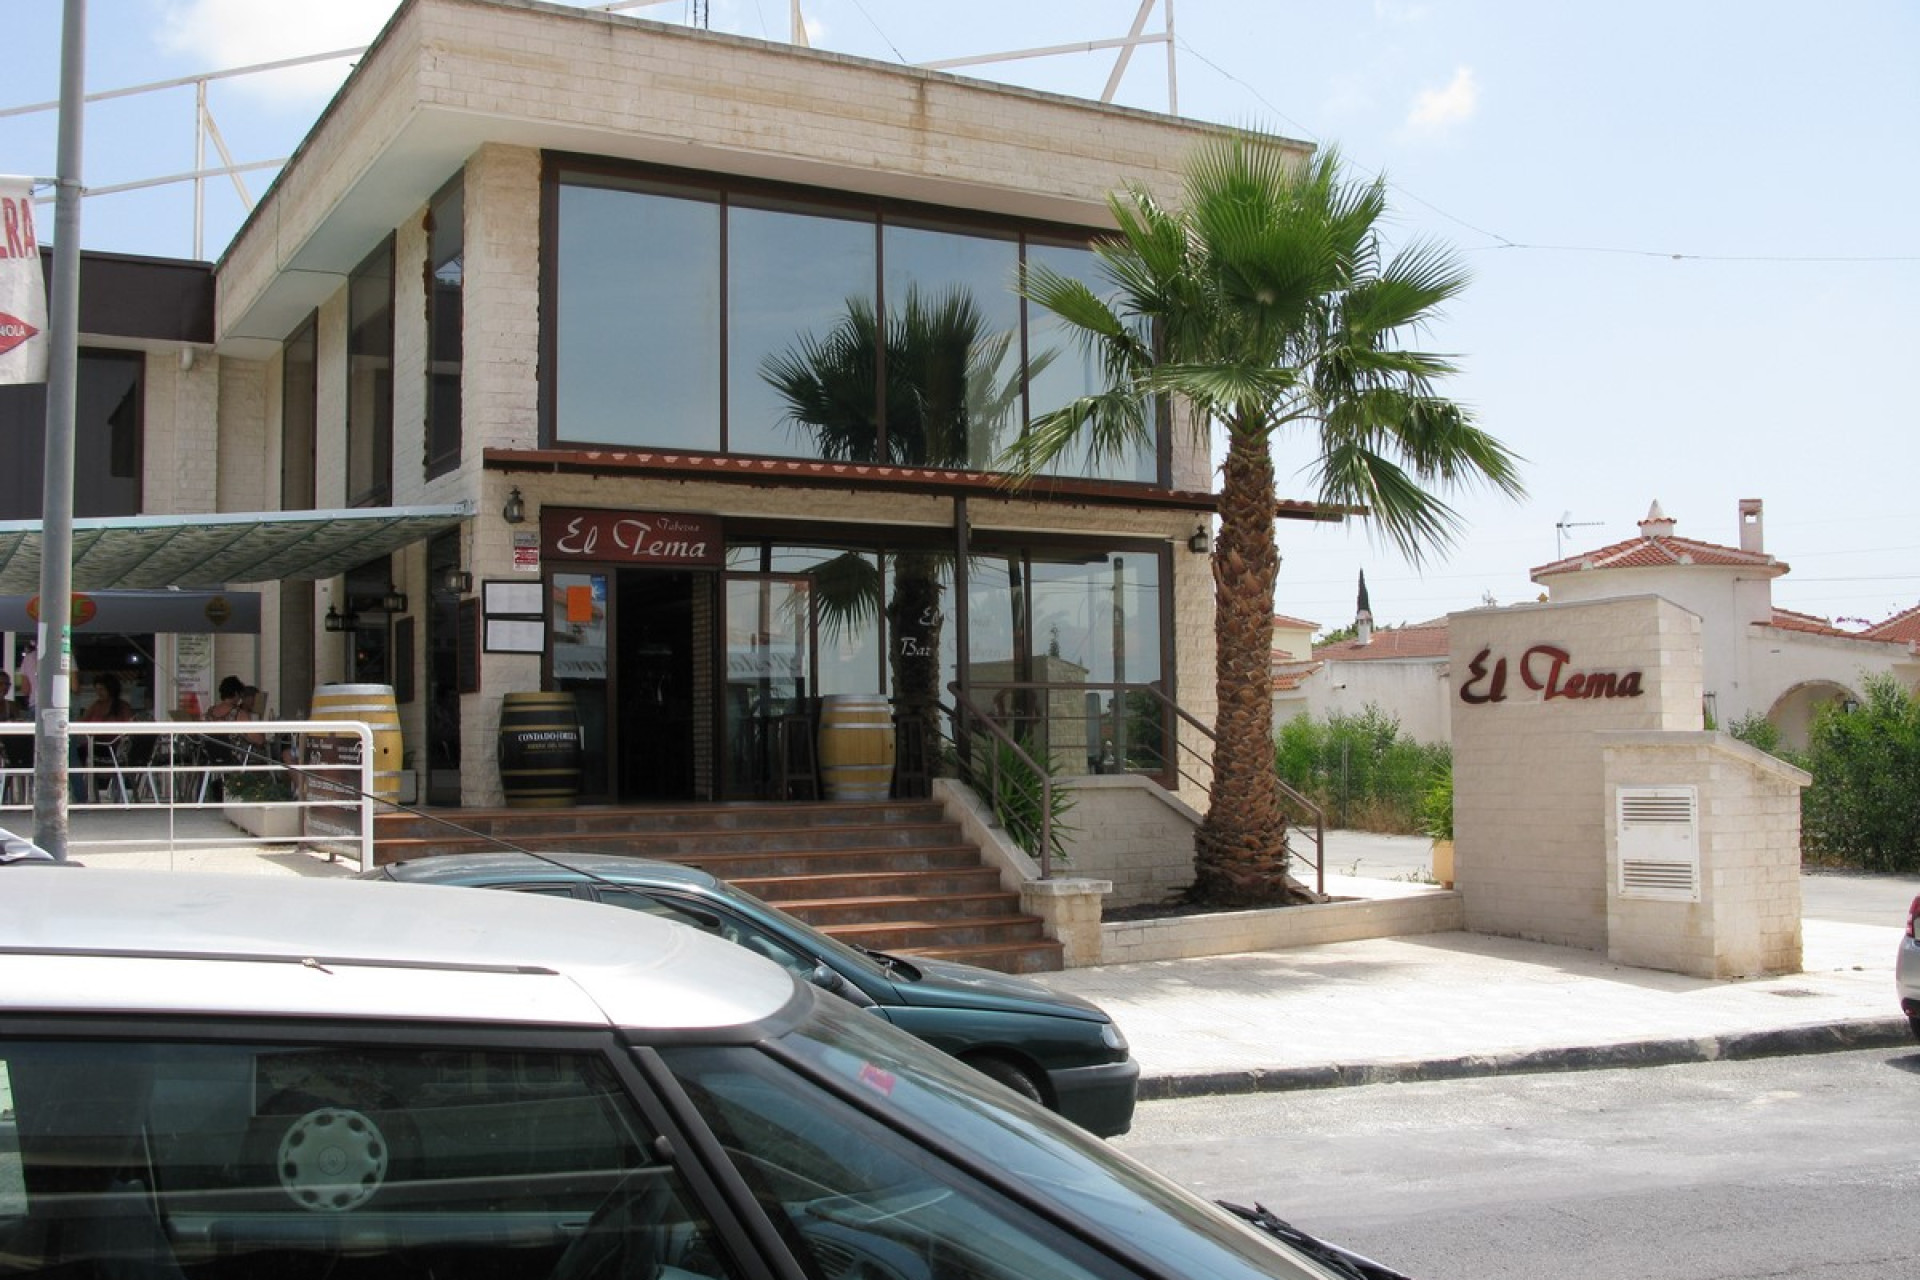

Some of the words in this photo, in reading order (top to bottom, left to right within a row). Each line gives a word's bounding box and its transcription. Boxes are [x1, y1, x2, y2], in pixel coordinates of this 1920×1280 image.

[0, 197, 37, 259] RA
[557, 516, 598, 554] El
[613, 519, 706, 558] Tema
[900, 636, 931, 656] Bar
[1460, 645, 1507, 704] El
[1520, 645, 1644, 701] Tema
